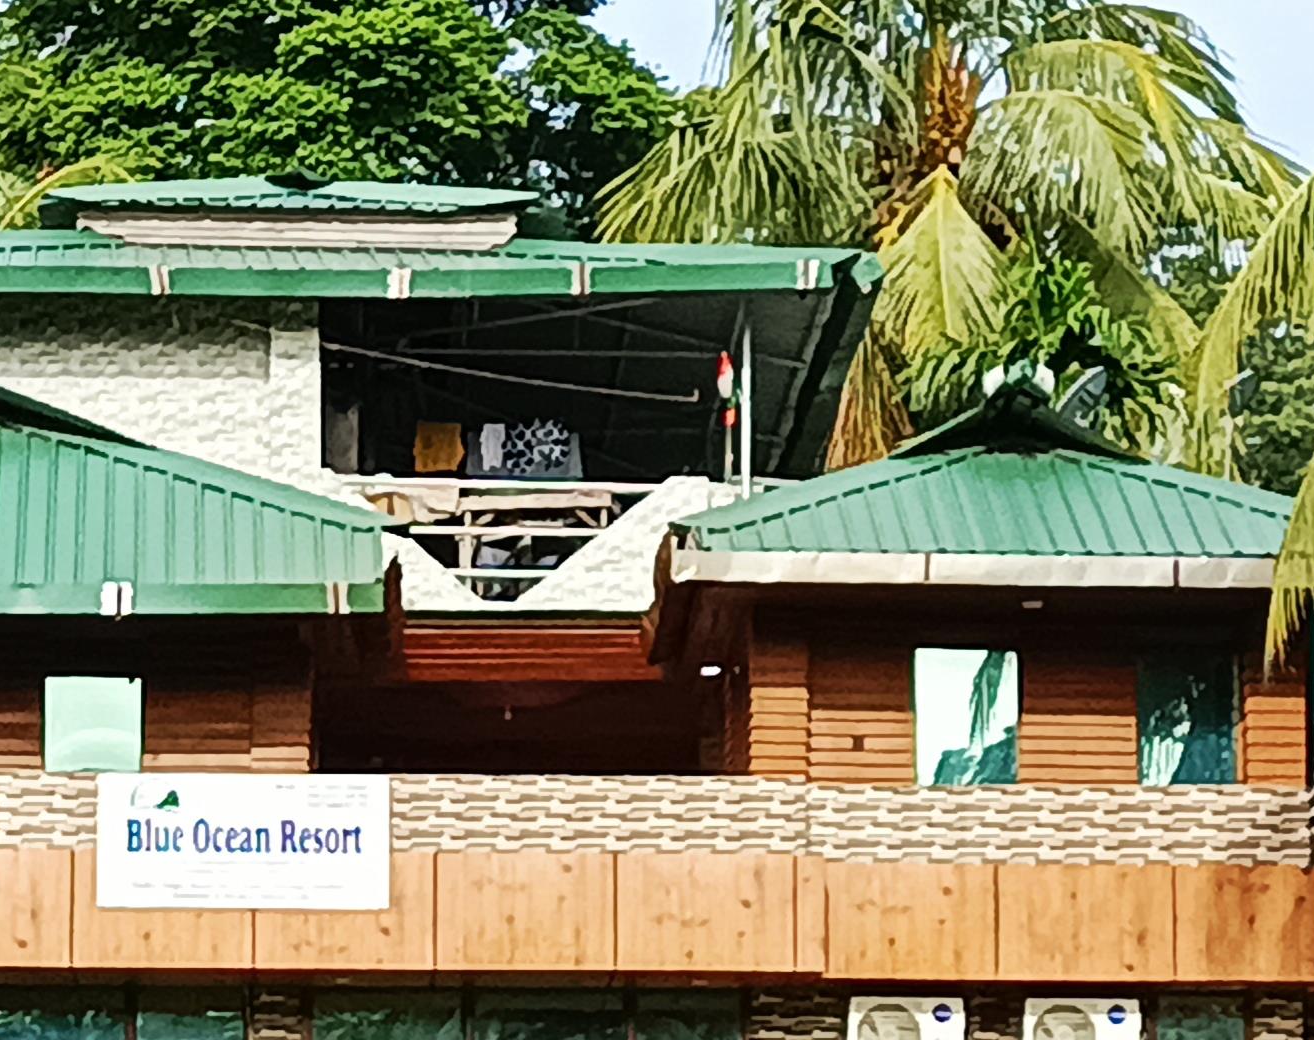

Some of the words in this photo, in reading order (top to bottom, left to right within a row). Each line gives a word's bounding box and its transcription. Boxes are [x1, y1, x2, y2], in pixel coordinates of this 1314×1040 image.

[126, 818, 184, 853] Blue
[192, 817, 271, 854] Ocean
[280, 819, 362, 855] Resort
